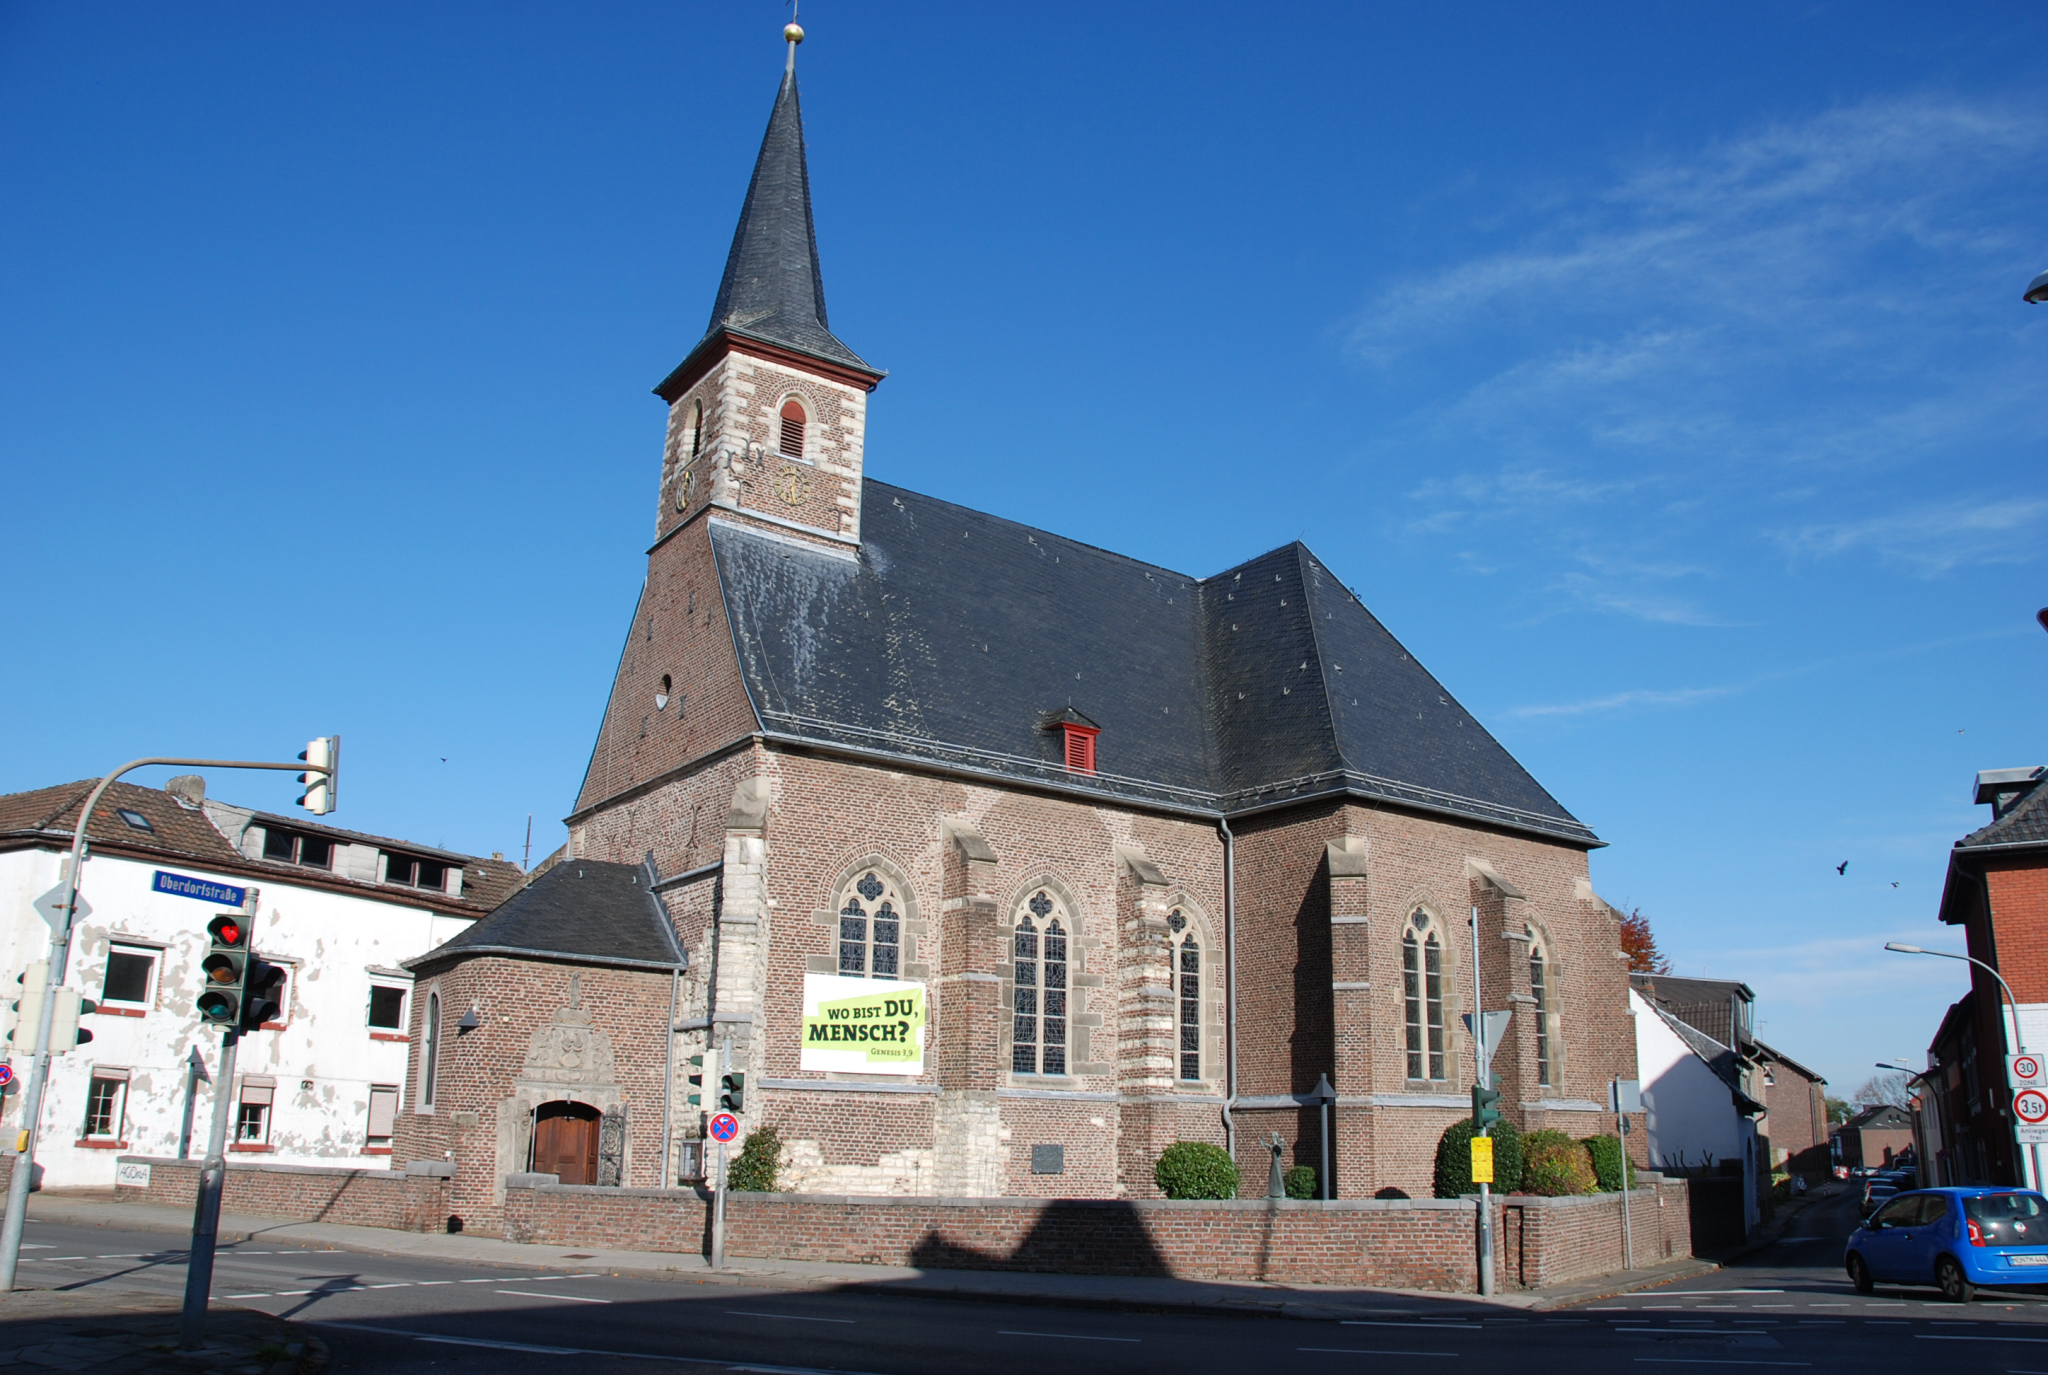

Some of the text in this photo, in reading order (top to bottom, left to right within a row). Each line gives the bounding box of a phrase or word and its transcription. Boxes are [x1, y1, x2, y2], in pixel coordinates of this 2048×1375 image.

[160, 875, 237, 902] Oberdorfstraße
[827, 999, 918, 1020] WO BIST DU,
[809, 1020, 910, 1043] MENSCH?
[902, 1049, 913, 1057] 3,9
[2019, 1062, 2034, 1073] 30
